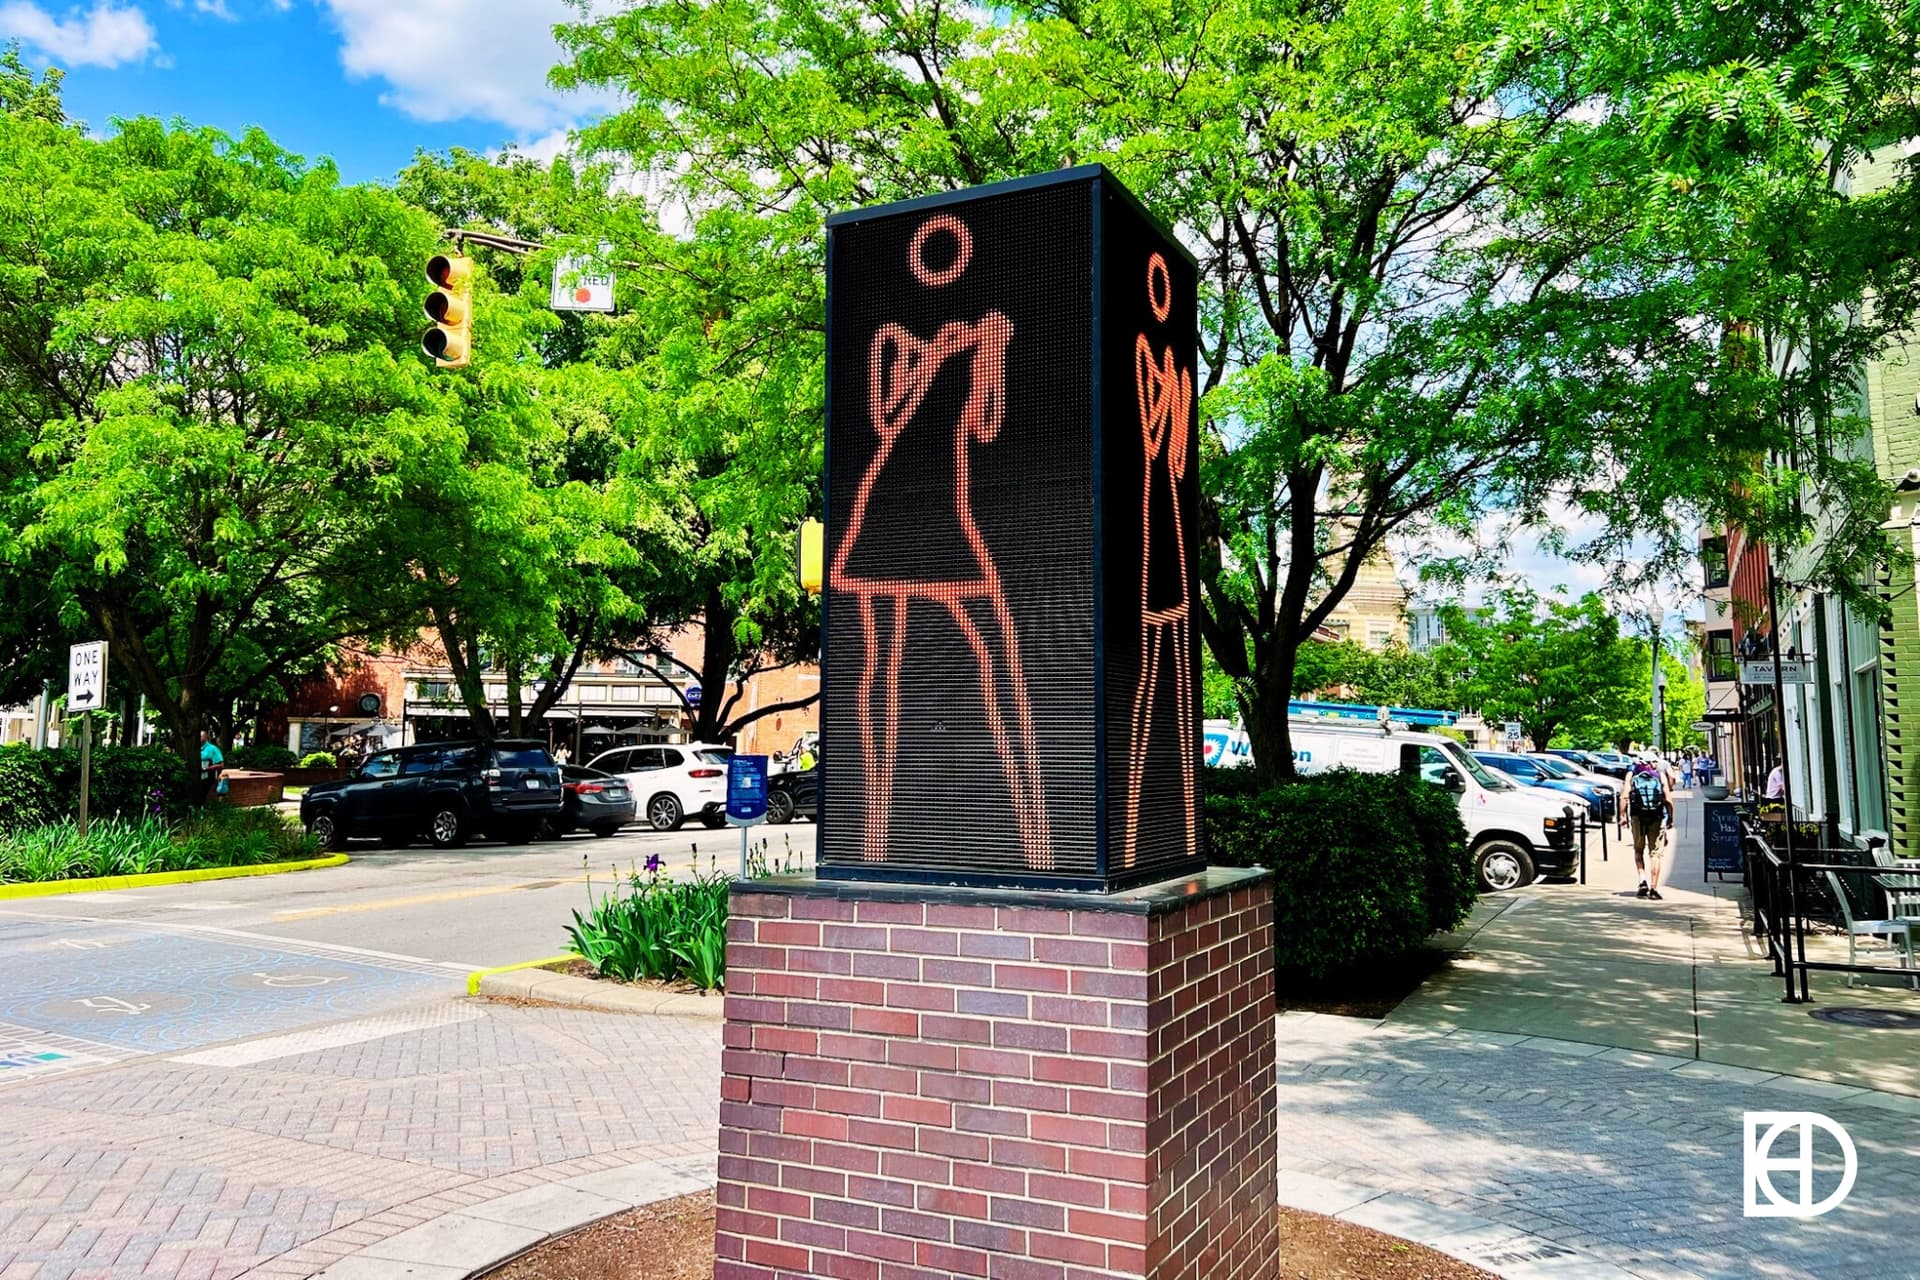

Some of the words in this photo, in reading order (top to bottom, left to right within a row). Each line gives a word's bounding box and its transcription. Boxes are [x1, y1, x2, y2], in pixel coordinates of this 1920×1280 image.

[583, 274, 609, 286] RED
[75, 650, 98, 667] ONE
[1753, 665, 1797, 673] TAVRN
[74, 670, 99, 687] WAY
[1507, 731, 1520, 740] 25
